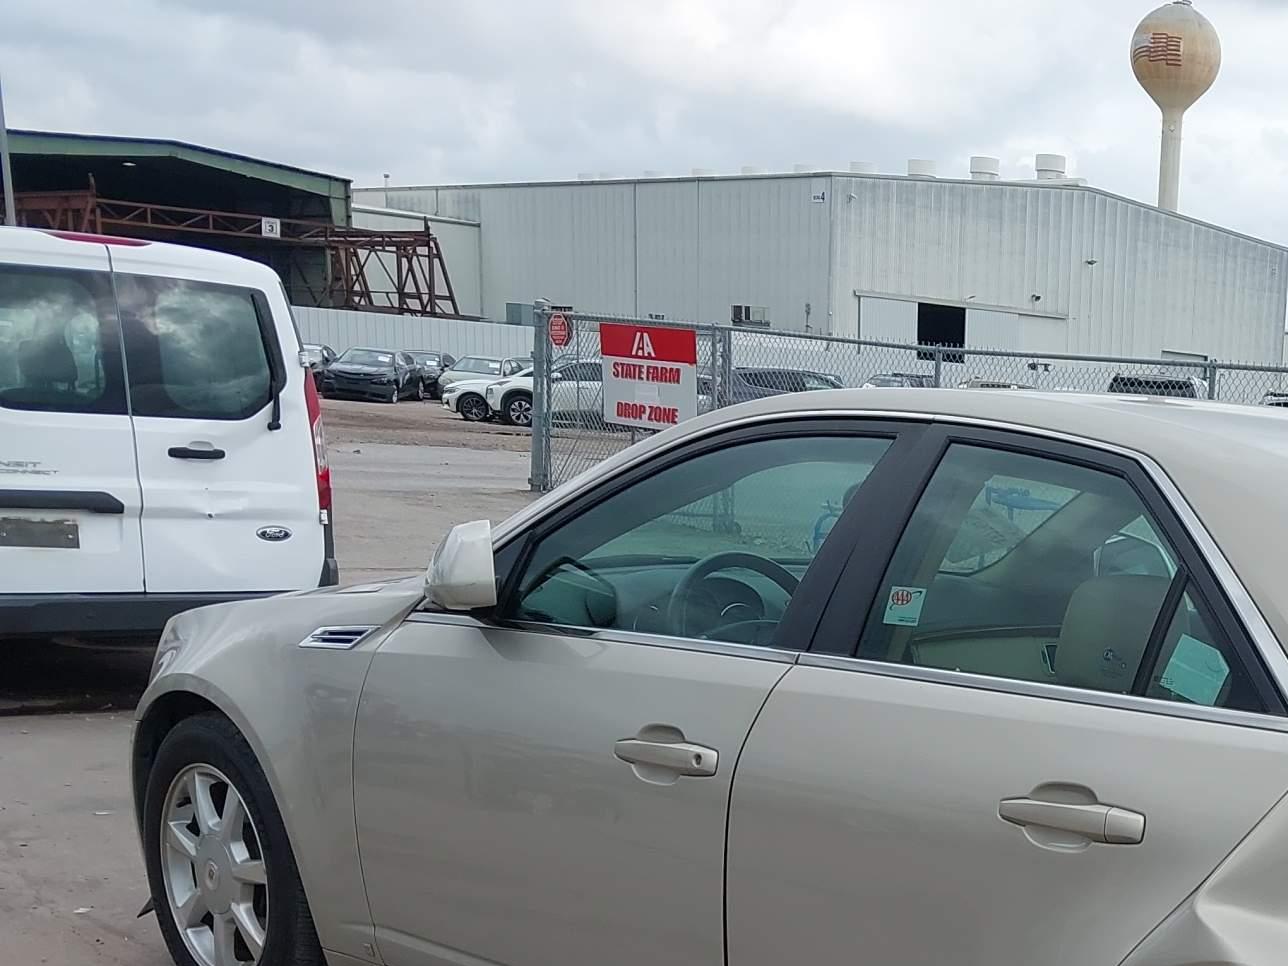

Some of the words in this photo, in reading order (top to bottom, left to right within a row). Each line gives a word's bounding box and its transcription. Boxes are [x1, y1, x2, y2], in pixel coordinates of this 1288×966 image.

[612, 362, 645, 381] STATE
[645, 366, 681, 385] FARM
[616, 401, 646, 419] DROP
[647, 406, 679, 425] ZONE
